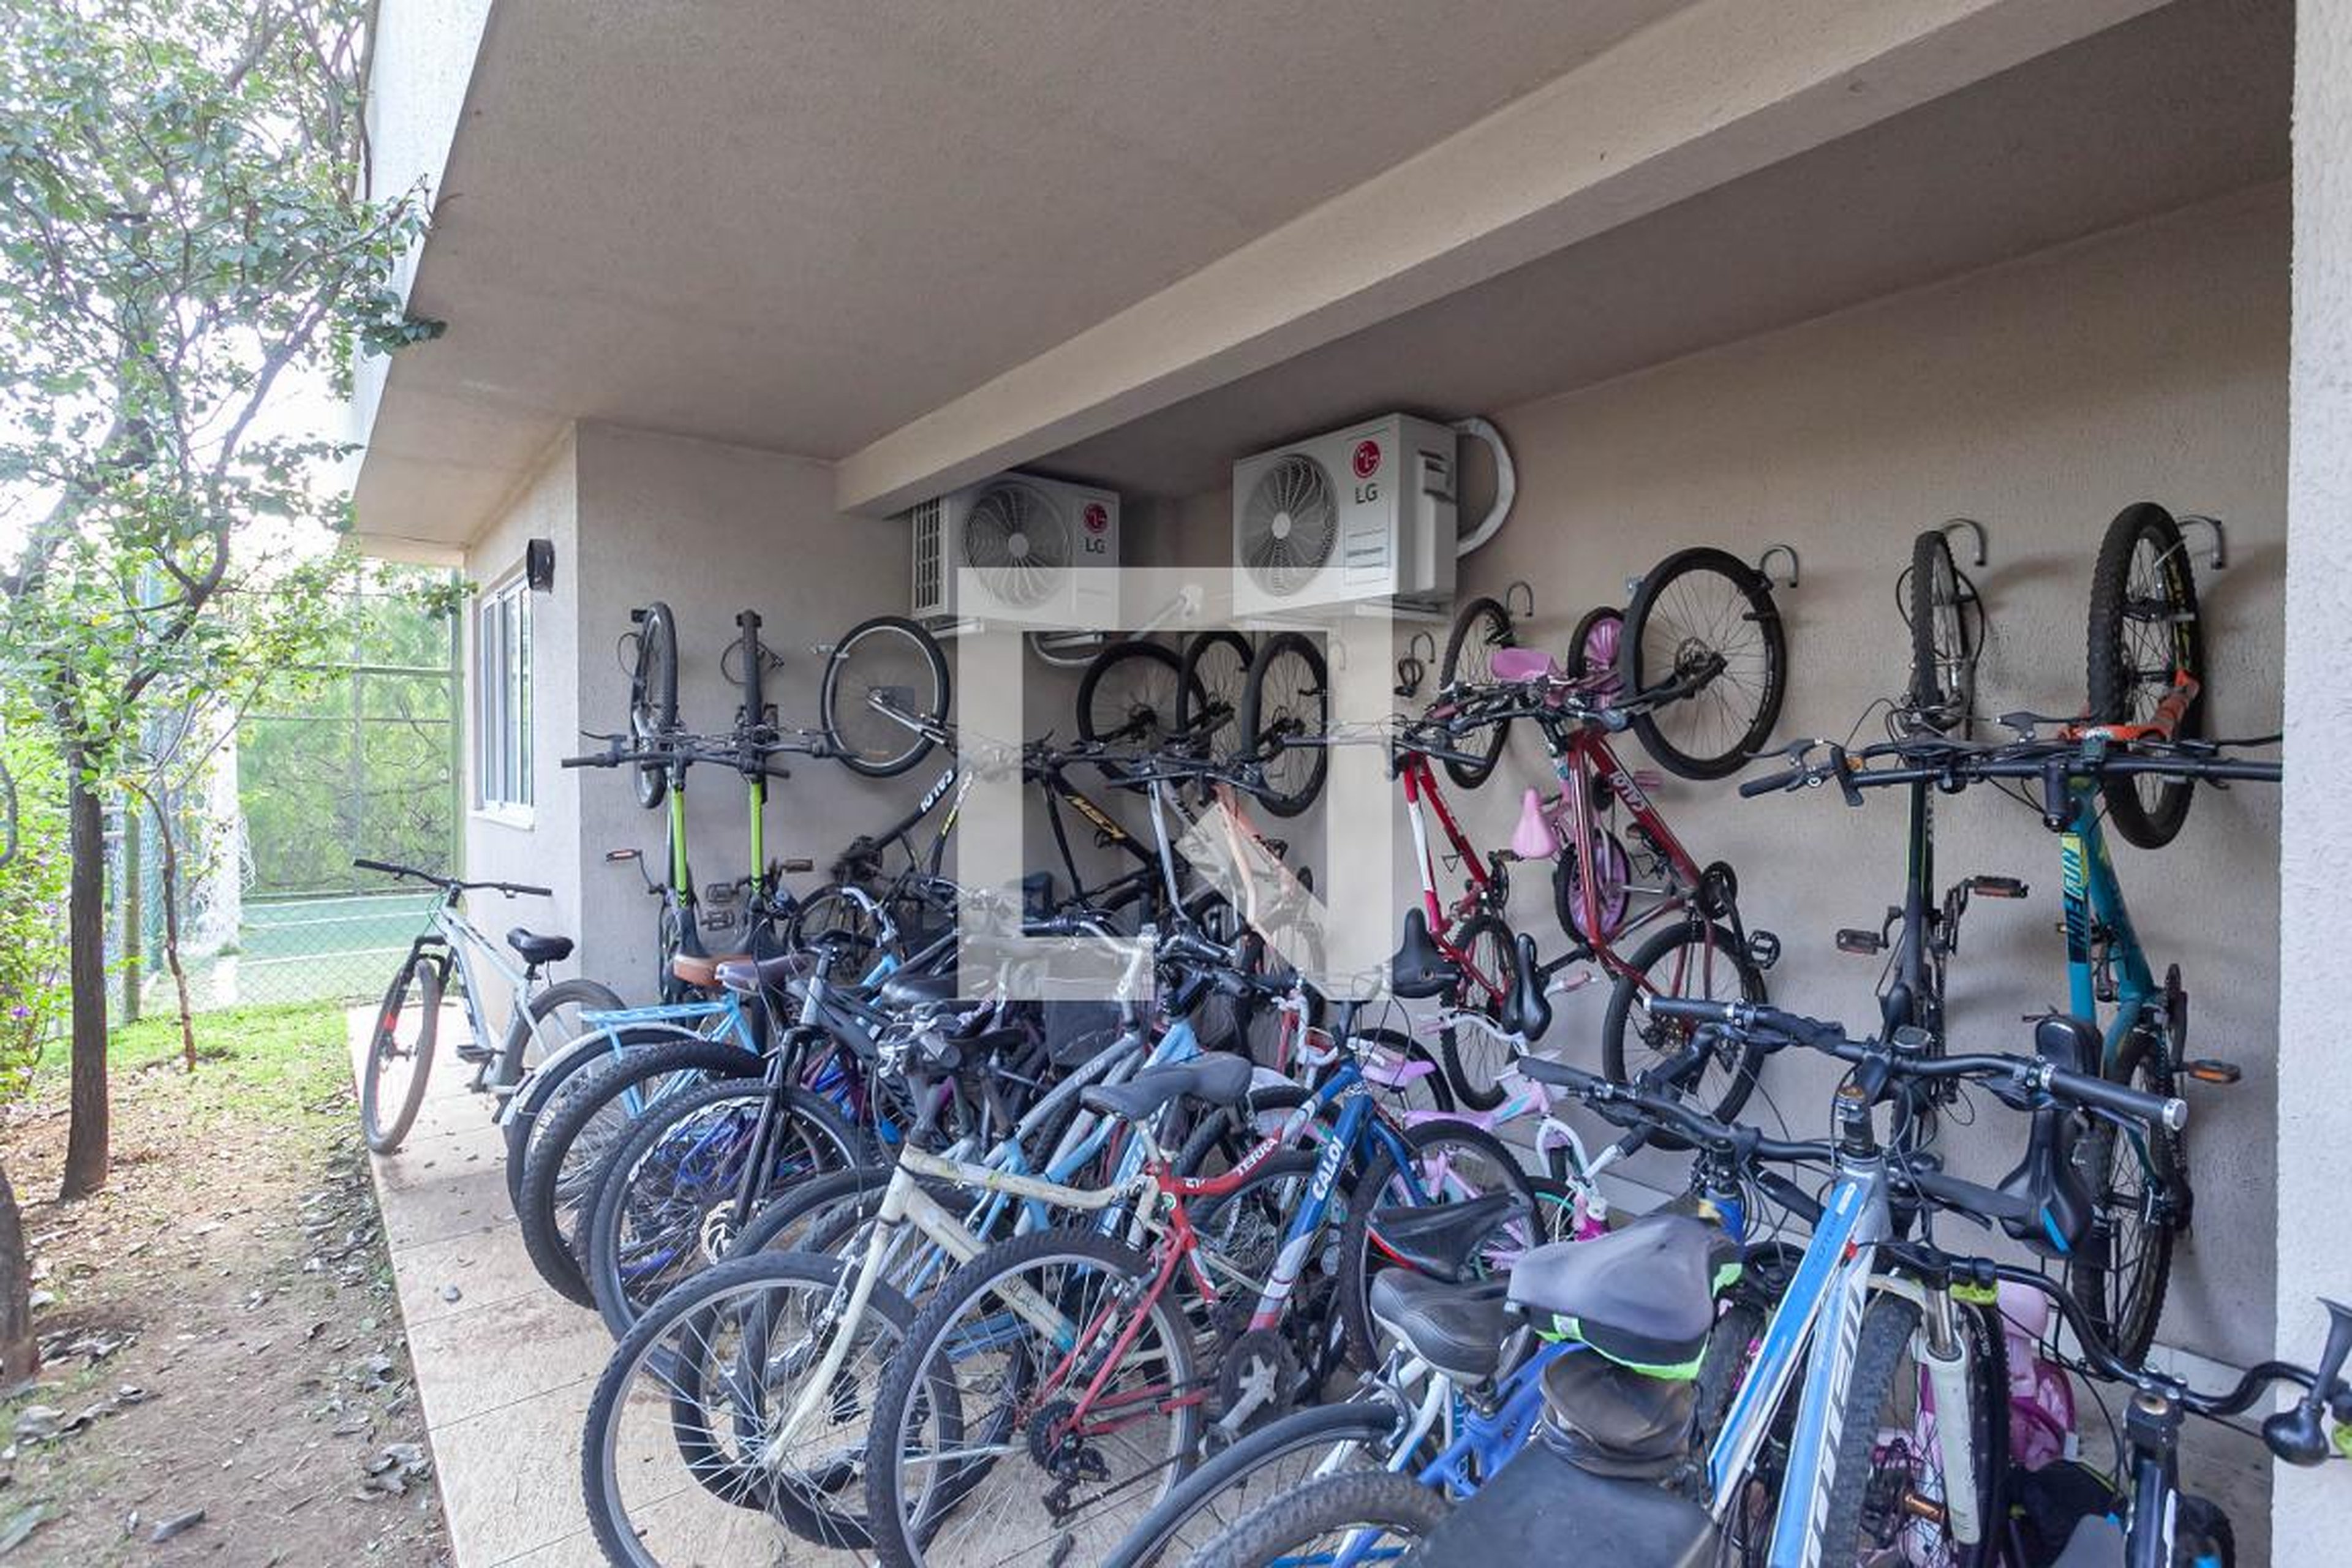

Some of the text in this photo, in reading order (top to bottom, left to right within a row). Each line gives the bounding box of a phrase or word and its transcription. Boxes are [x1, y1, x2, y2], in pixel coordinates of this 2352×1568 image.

[1355, 483, 1378, 503] LG
[1085, 537, 1106, 554] LG
[920, 769, 954, 813] CALOI
[1608, 771, 1646, 812] CALOI
[1232, 1138, 1278, 1176] TERRA
[1312, 1135, 1345, 1200] CALOI
